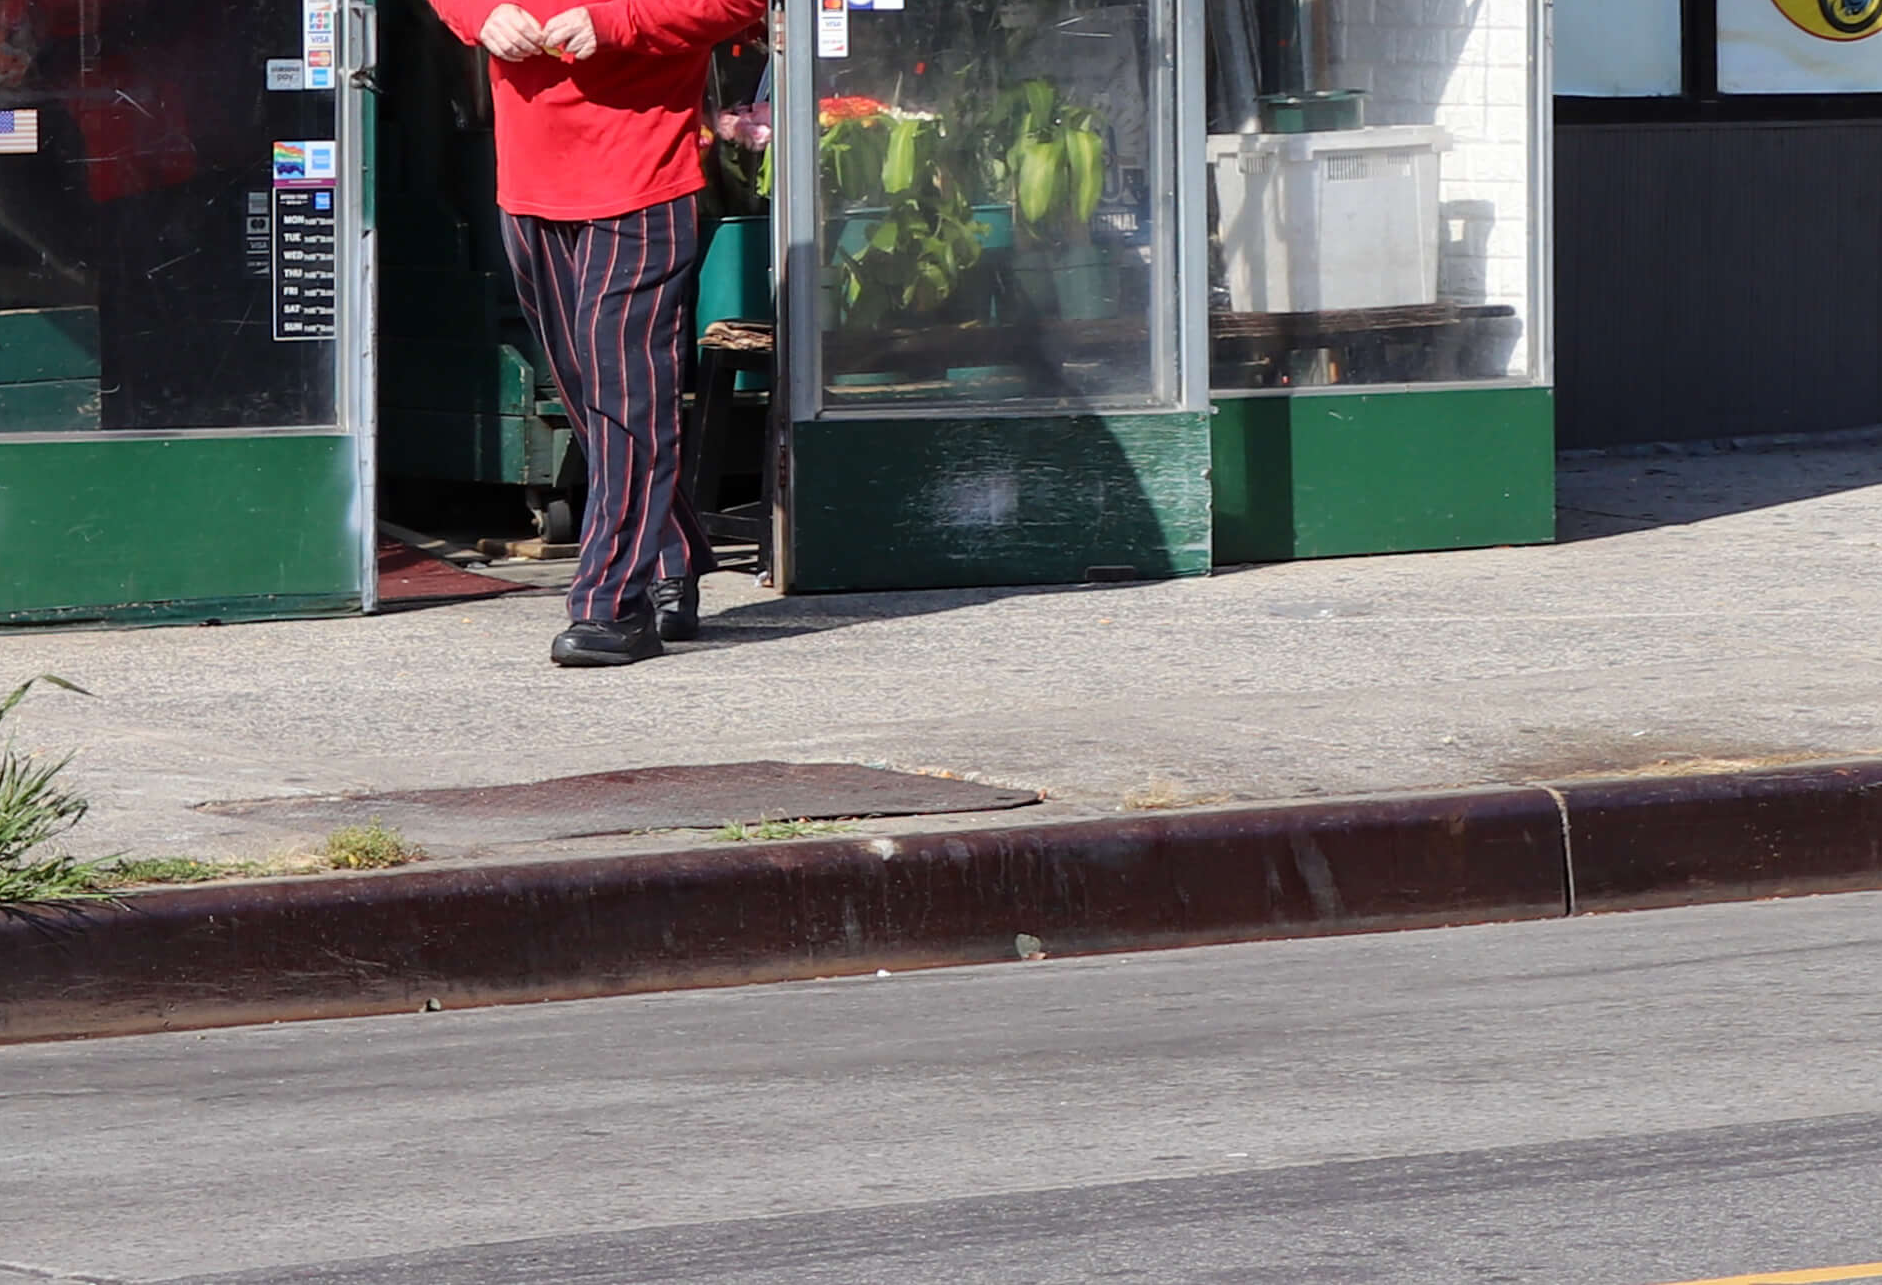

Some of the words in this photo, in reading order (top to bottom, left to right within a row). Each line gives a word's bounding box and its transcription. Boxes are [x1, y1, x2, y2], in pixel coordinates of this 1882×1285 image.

[311, 35, 330, 45] VISA
[283, 215, 305, 225] MON
[283, 232, 302, 242] TUE
[283, 250, 304, 261] WED
[283, 268, 303, 278] THU
[283, 286, 299, 296] FRI
[283, 304, 302, 314] SAT
